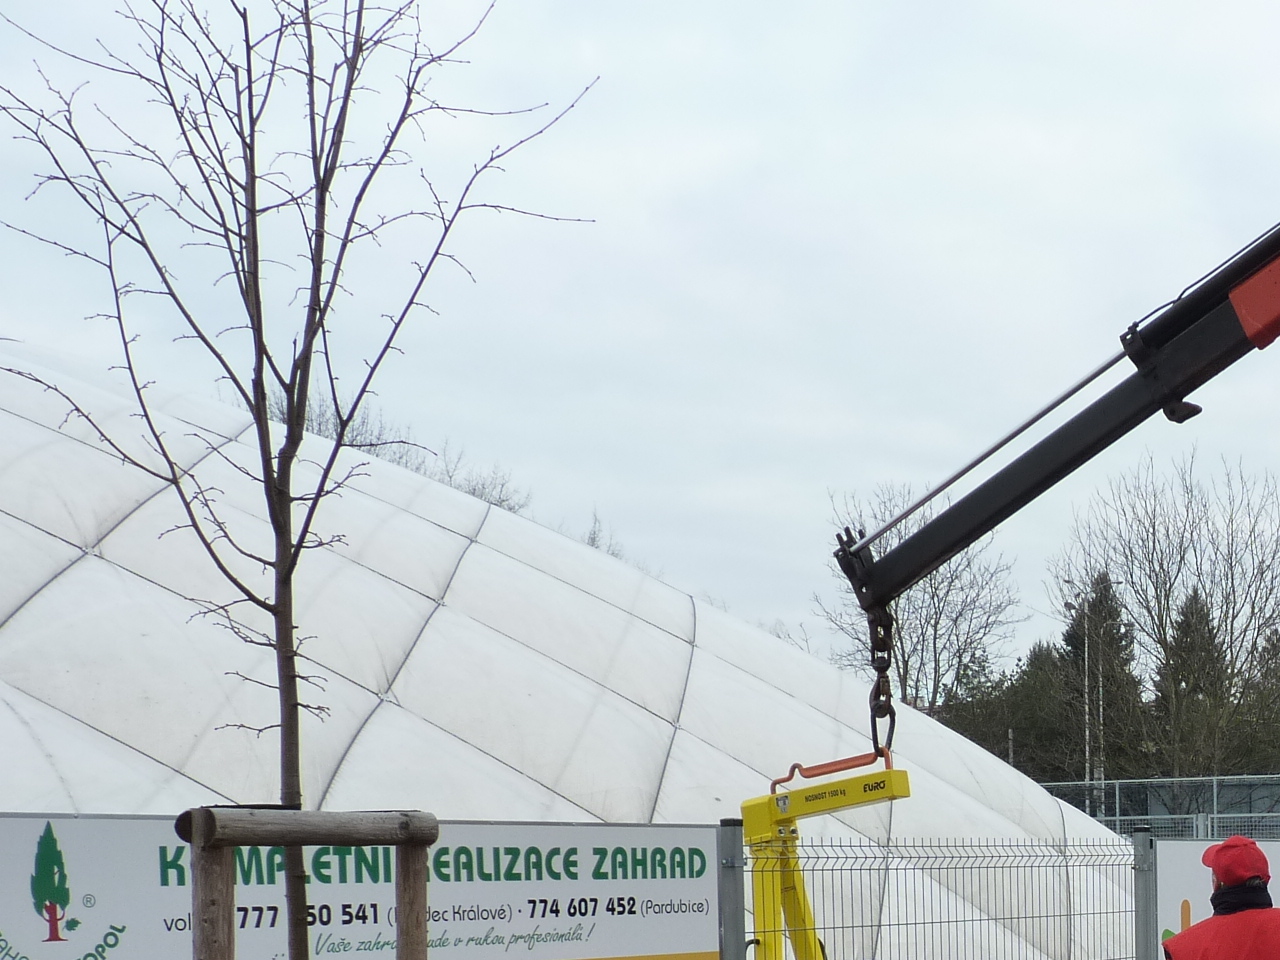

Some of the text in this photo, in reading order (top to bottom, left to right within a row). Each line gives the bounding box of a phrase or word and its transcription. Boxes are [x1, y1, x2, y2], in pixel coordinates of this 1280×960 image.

[828, 789, 839, 798] 1500
[839, 788, 846, 797] kg
[863, 780, 886, 793] EURO
[426, 846, 579, 883] EALIZACE
[591, 846, 707, 881] ZAHRAD
[236, 905, 279, 929] 777
[304, 904, 332, 926] 50
[341, 902, 379, 926] 541
[452, 902, 513, 923] Králové)
[527, 898, 560, 919] 774
[567, 897, 599, 918] 607
[605, 896, 637, 916] 452
[640, 897, 710, 918] (Pardubice)
[315, 932, 352, 955] Vaše
[427, 930, 451, 950] ude
[453, 935, 464, 947] v
[465, 927, 506, 947] rukou
